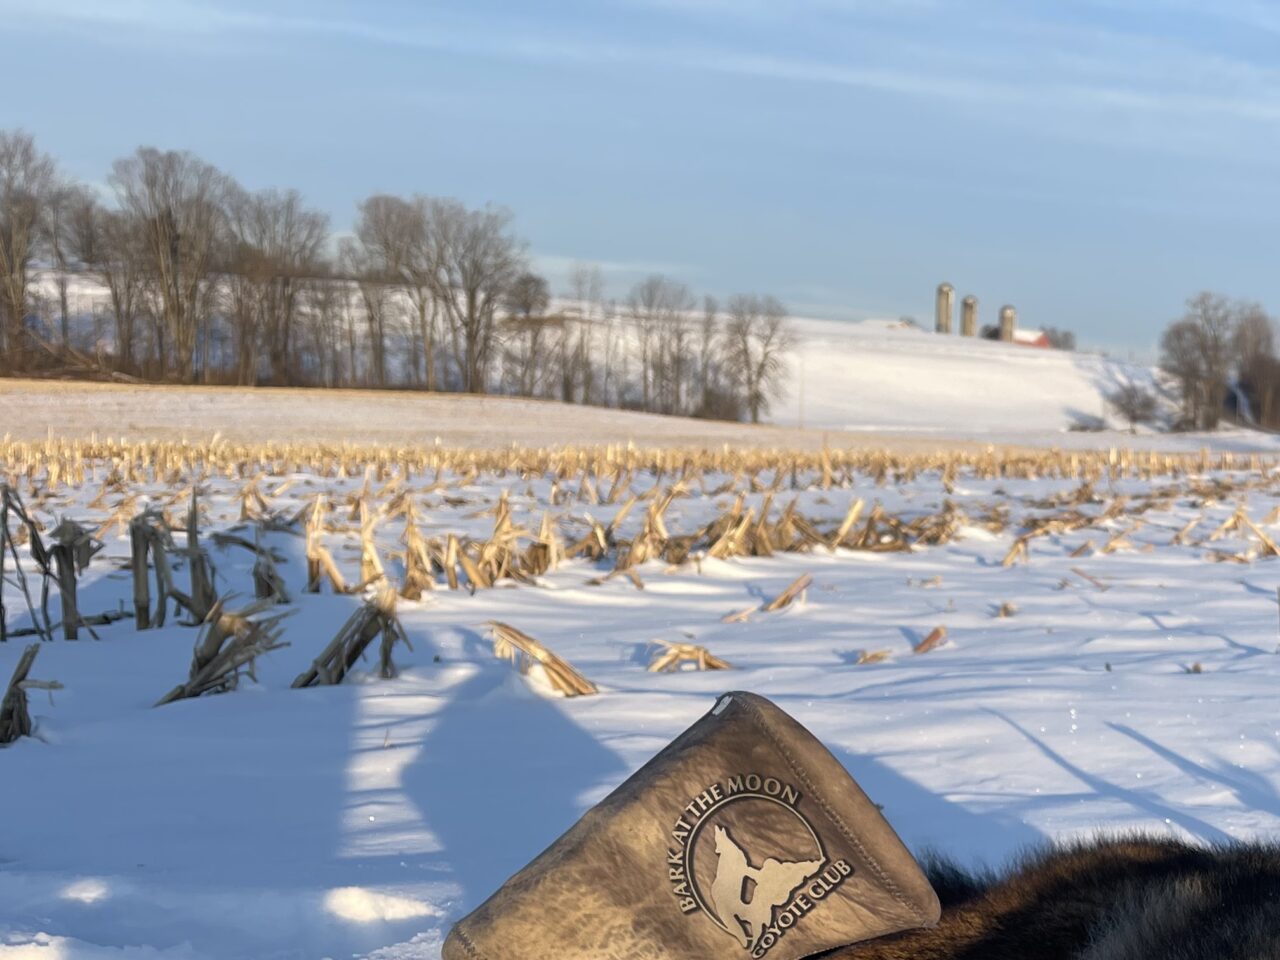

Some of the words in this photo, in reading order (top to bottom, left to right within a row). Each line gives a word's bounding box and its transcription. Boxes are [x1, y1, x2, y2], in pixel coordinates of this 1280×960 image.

[686, 783, 723, 818] THE
[727, 774, 799, 805] MOON
[672, 816, 692, 845] AT
[668, 847, 697, 912] BARK
[752, 895, 812, 959] COYOTE
[809, 859, 851, 900] CLUB
